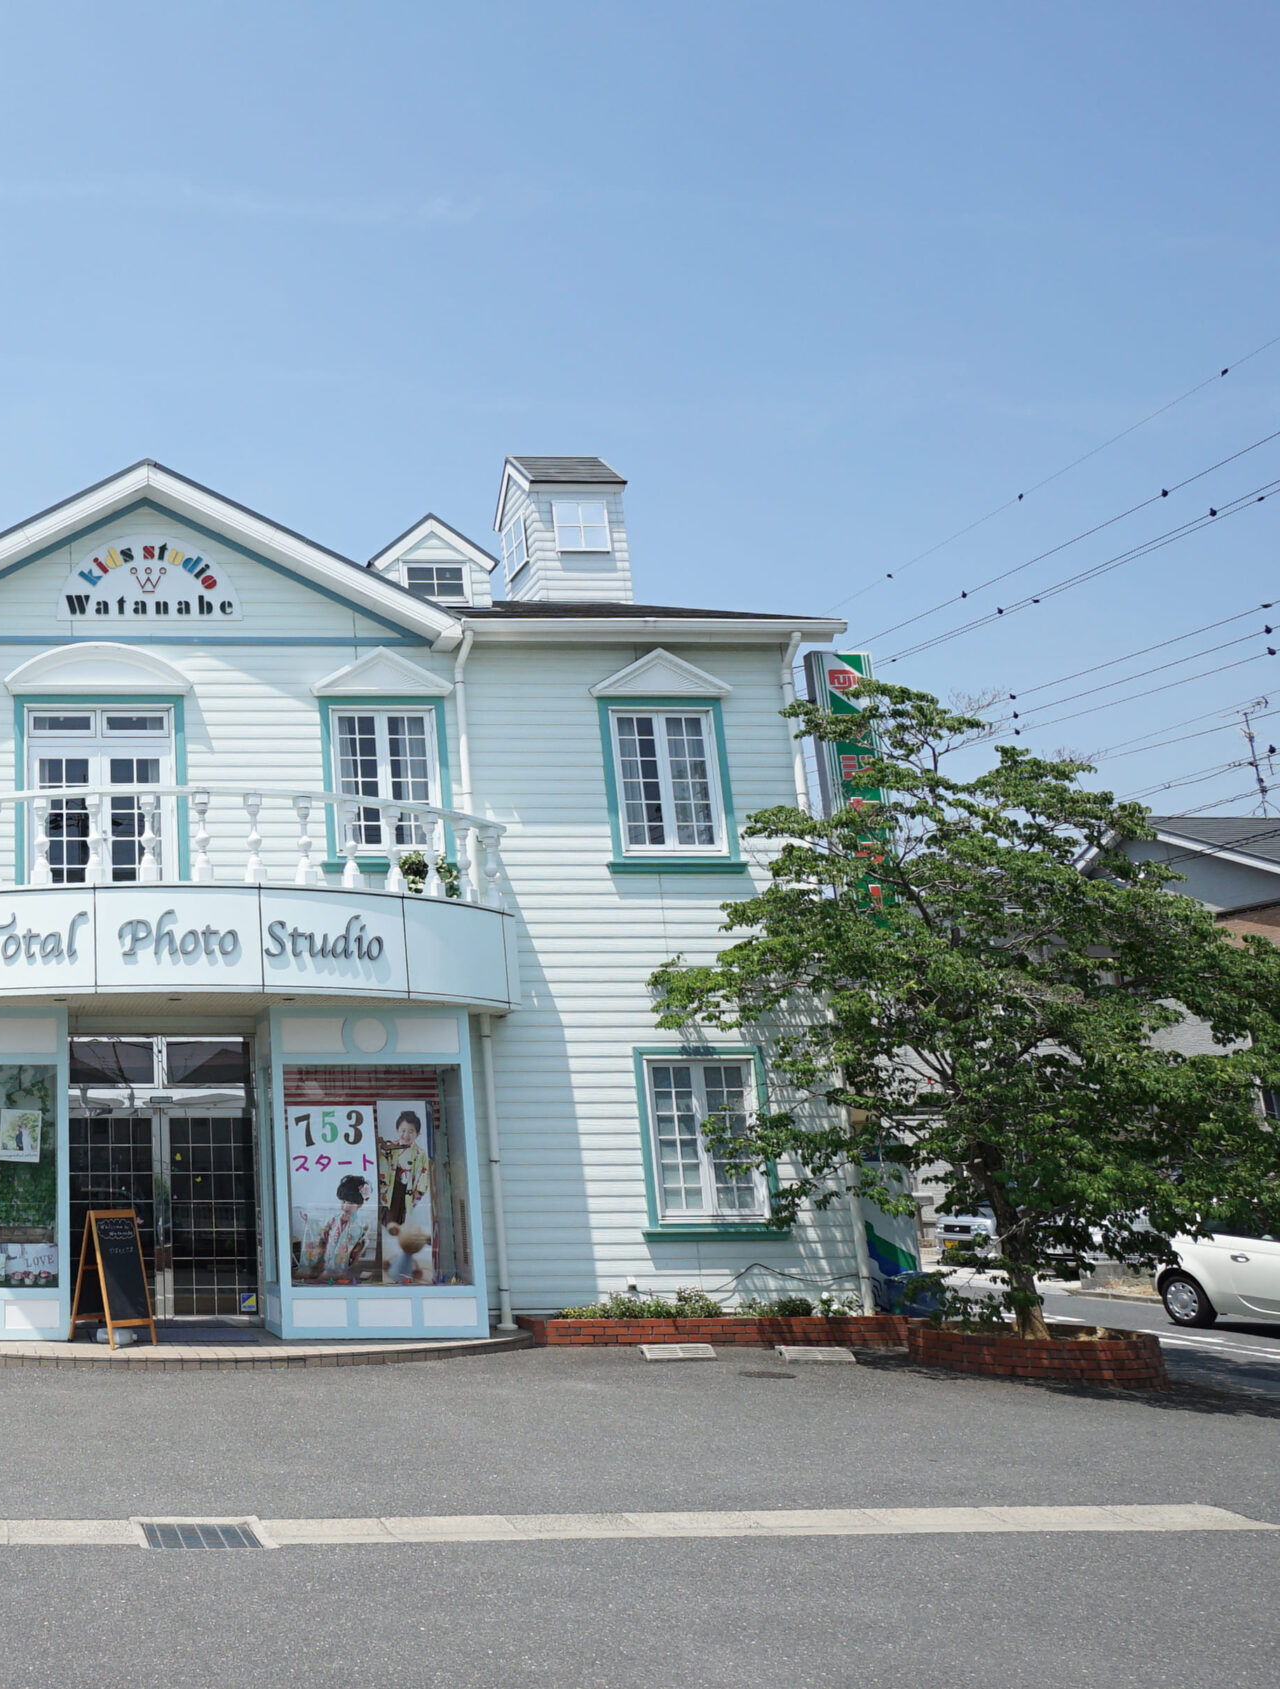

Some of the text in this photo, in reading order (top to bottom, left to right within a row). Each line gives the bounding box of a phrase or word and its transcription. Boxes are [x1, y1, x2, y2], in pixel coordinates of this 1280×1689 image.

[78, 543, 217, 590] kids studio
[65, 595, 233, 615] Watanabe
[118, 909, 239, 957] Photo
[264, 914, 385, 961] Studio
[294, 1110, 365, 1148] 753
[292, 1153, 375, 1173] スタート
[24, 1253, 54, 1268] LOVE
